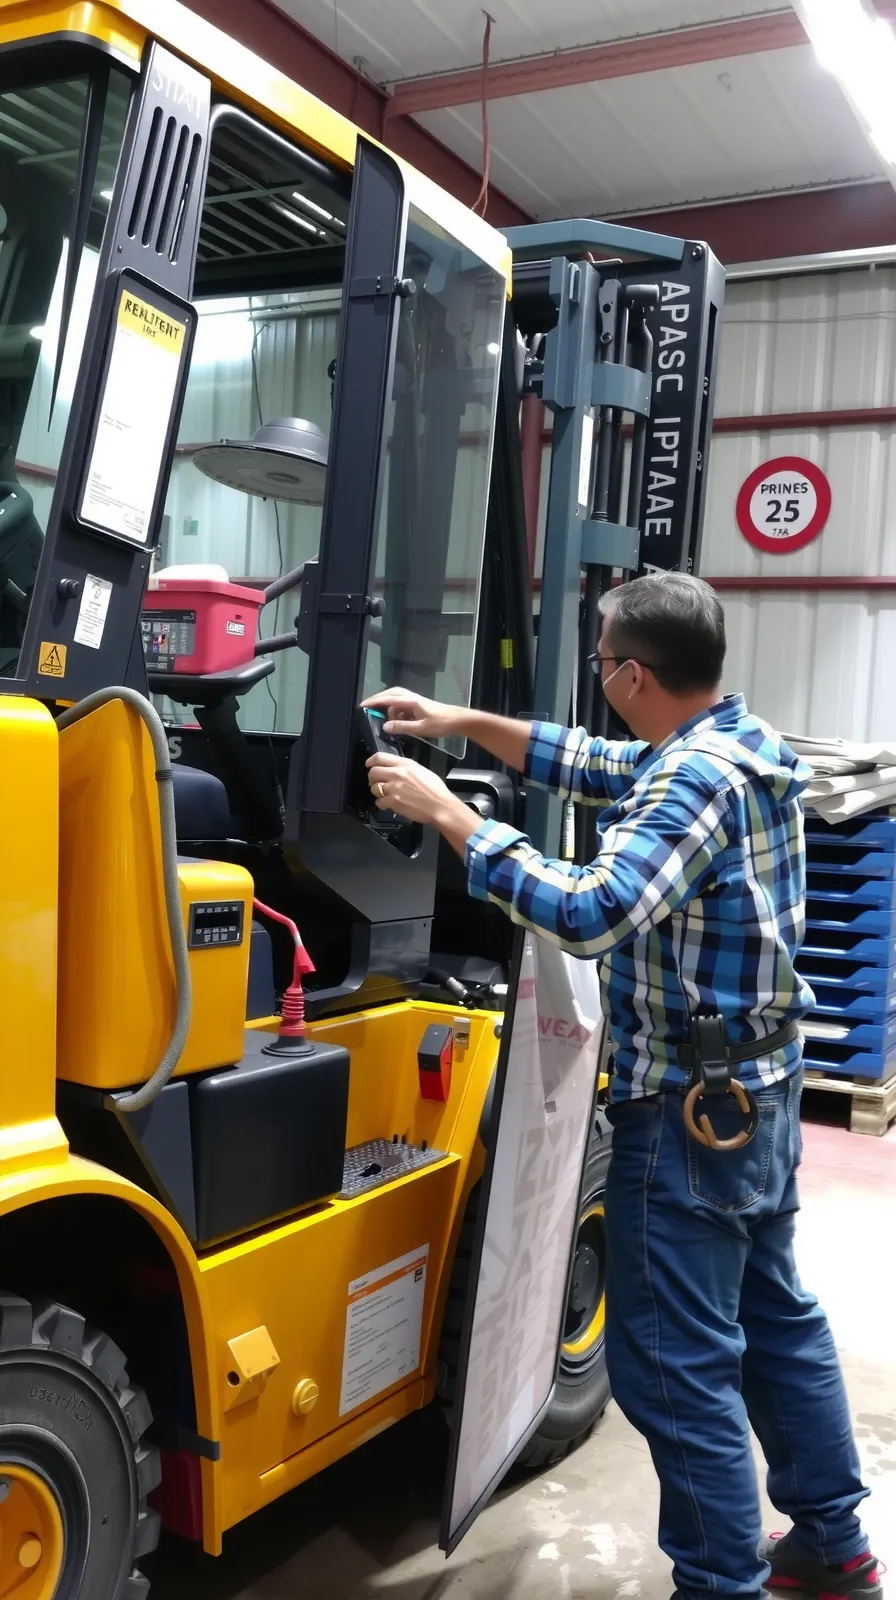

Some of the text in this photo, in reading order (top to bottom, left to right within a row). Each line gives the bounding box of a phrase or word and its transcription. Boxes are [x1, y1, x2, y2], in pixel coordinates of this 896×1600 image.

[656, 280, 690, 392] APASC
[644, 417, 681, 536] IPTAAE
[761, 482, 808, 494] PRINES
[765, 500, 800, 522] 25
